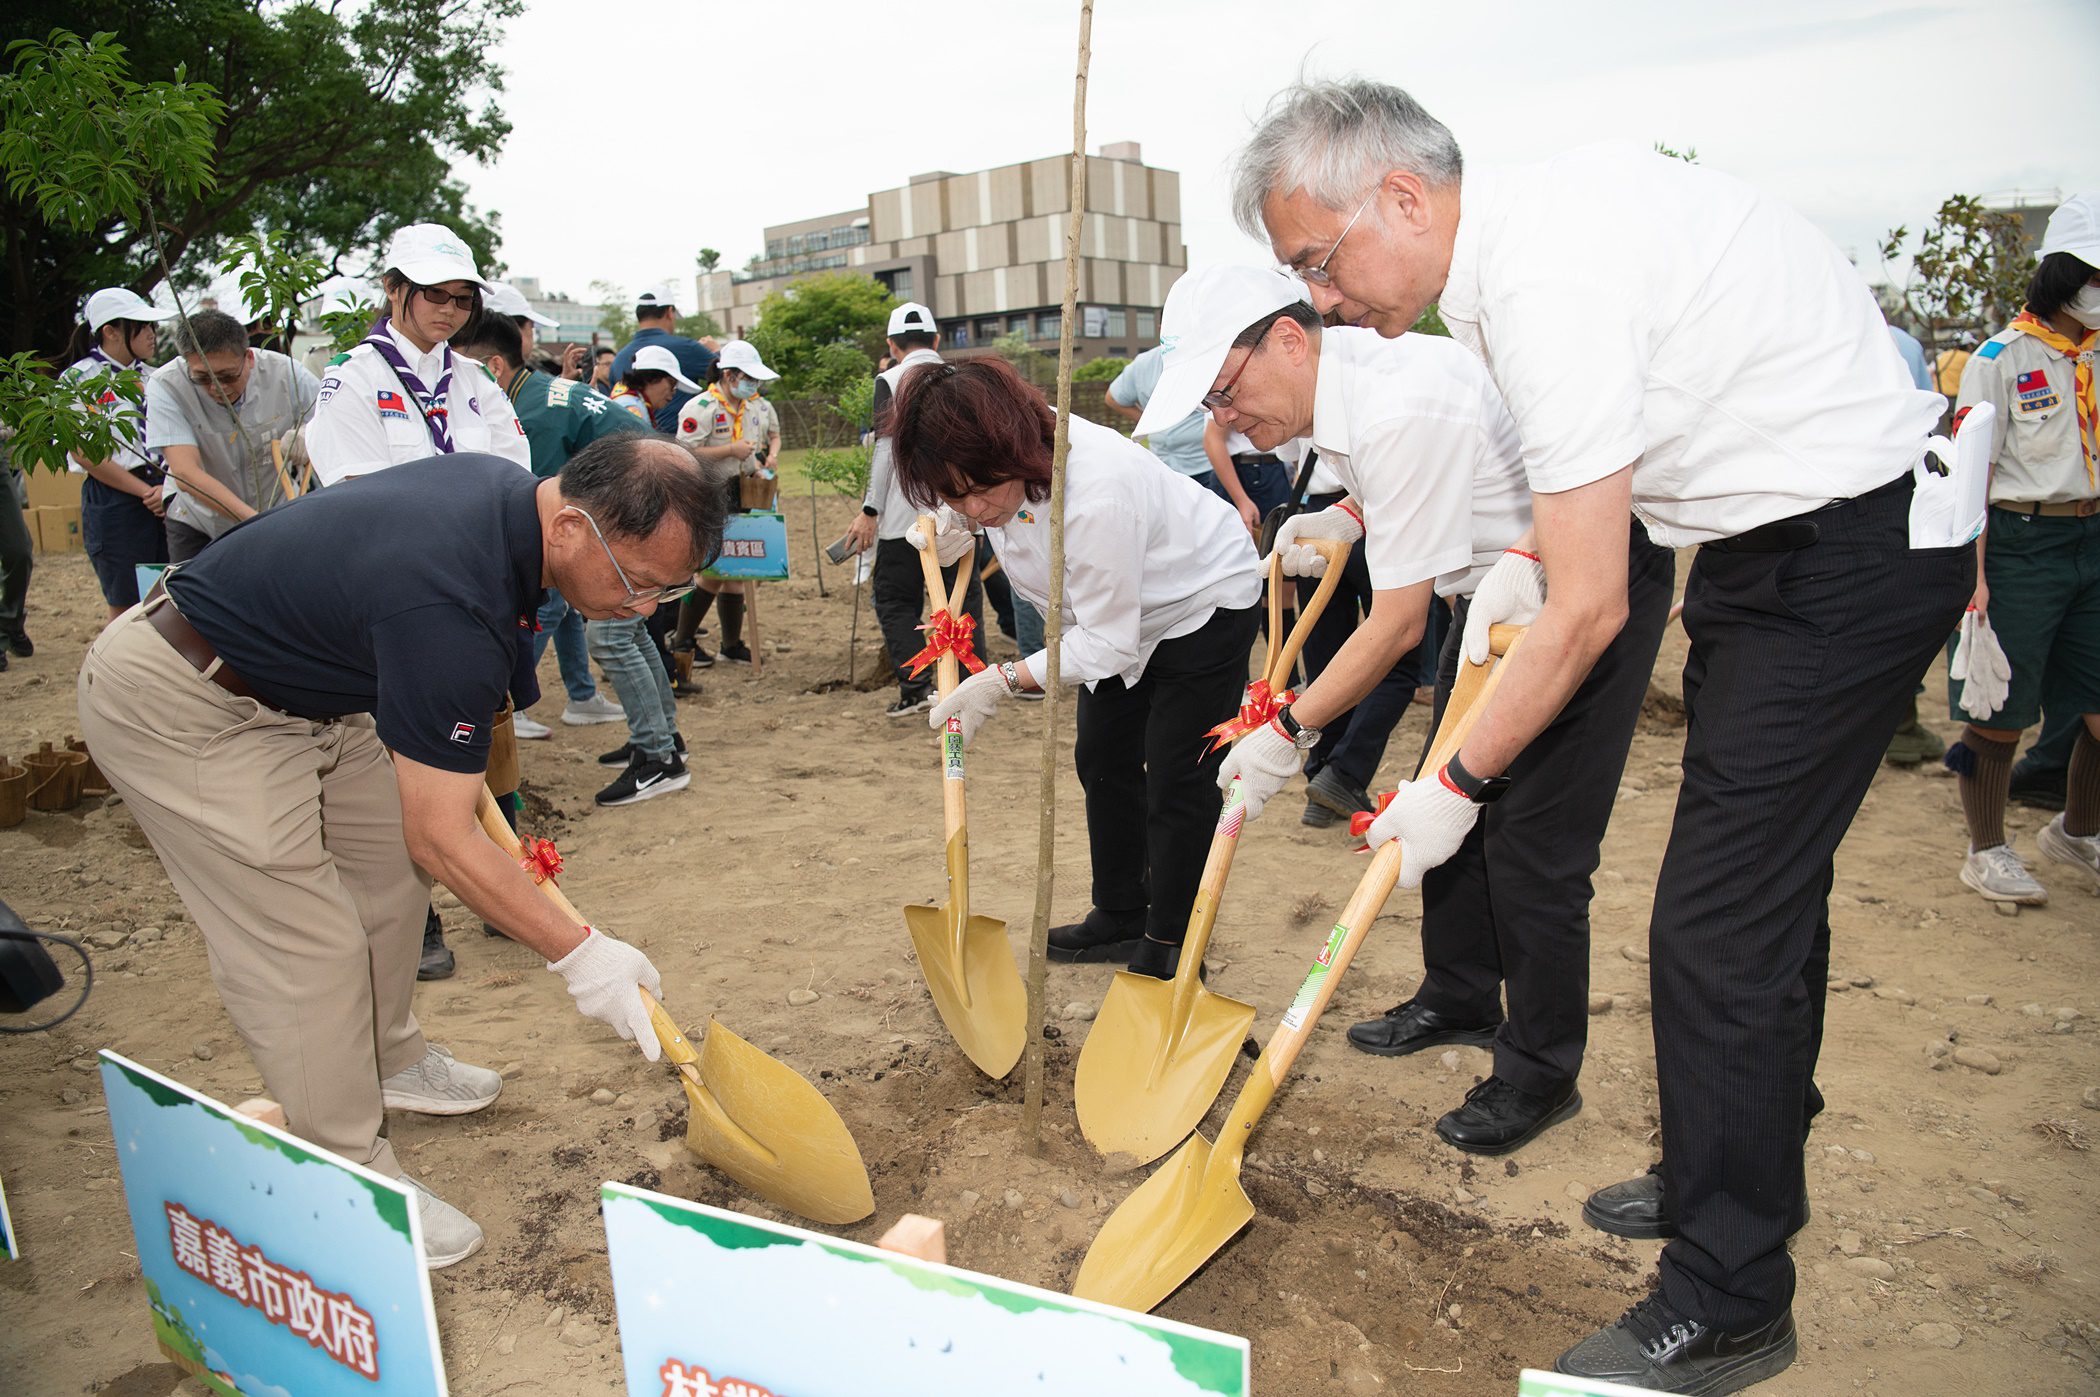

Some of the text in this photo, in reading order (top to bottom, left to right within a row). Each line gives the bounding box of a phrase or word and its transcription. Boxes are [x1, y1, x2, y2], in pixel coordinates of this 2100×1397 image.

[167, 1206, 378, 1375] 嘉義市政府
